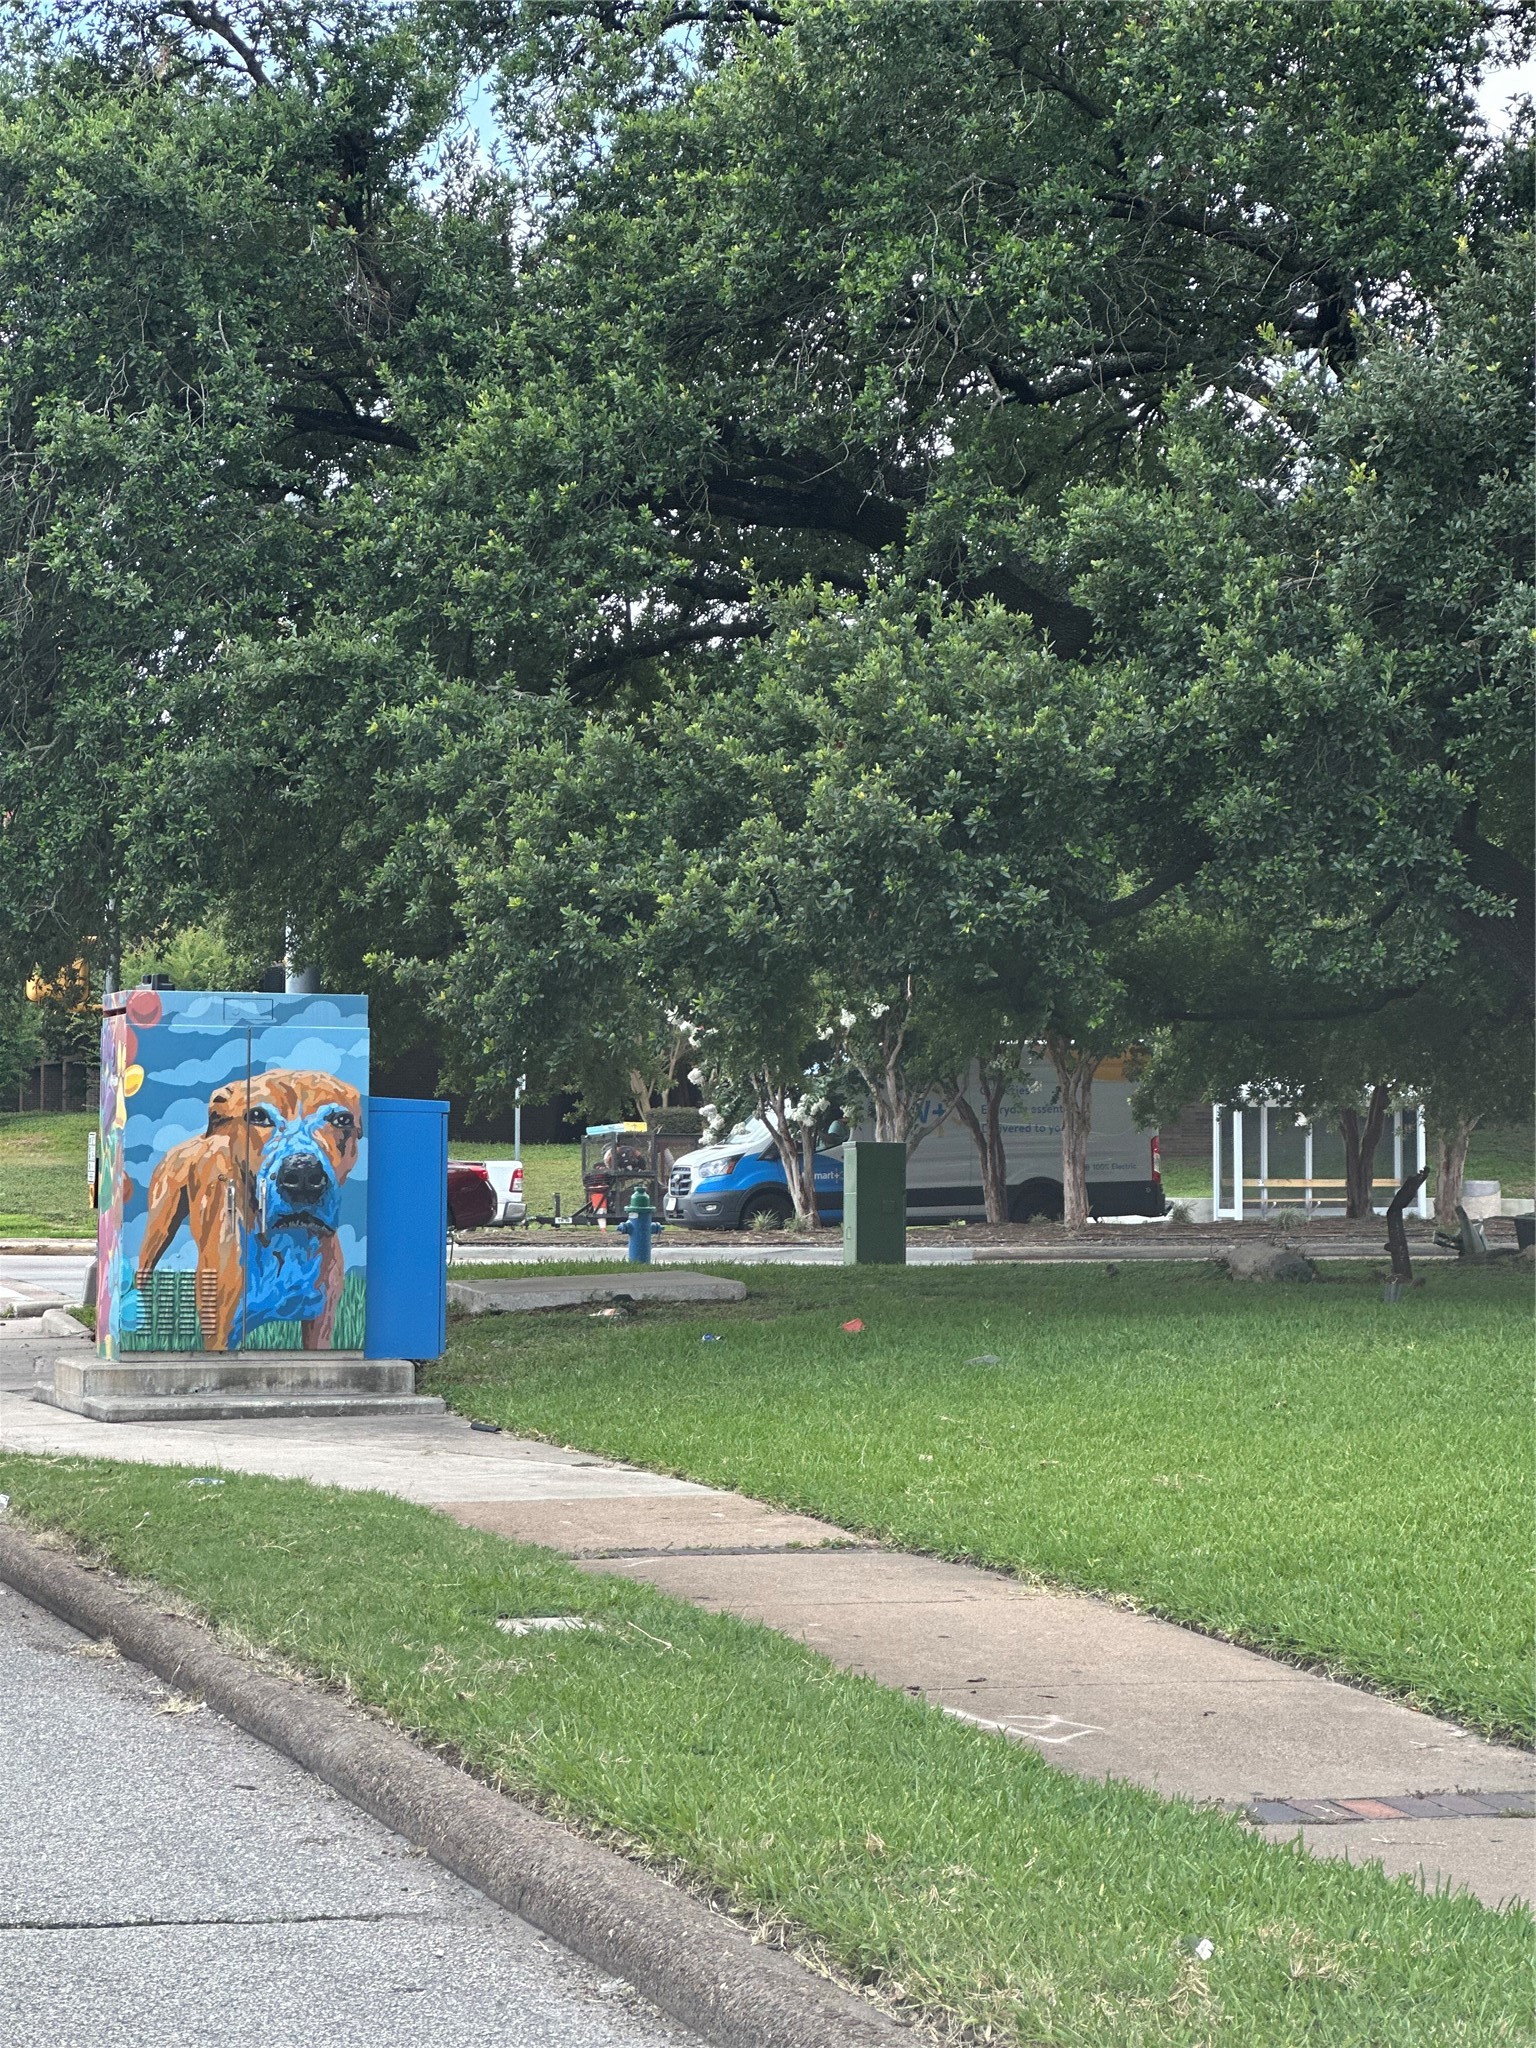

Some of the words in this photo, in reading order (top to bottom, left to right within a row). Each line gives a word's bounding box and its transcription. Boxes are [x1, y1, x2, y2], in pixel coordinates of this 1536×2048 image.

[1031, 1105, 1064, 1114] essent
[981, 1123, 1032, 1133] Divered
[1035, 1124, 1046, 1133] to
[1048, 1125, 1064, 1135] yo
[1111, 1162, 1137, 1170] Electric
[814, 1171, 840, 1180] mart+
